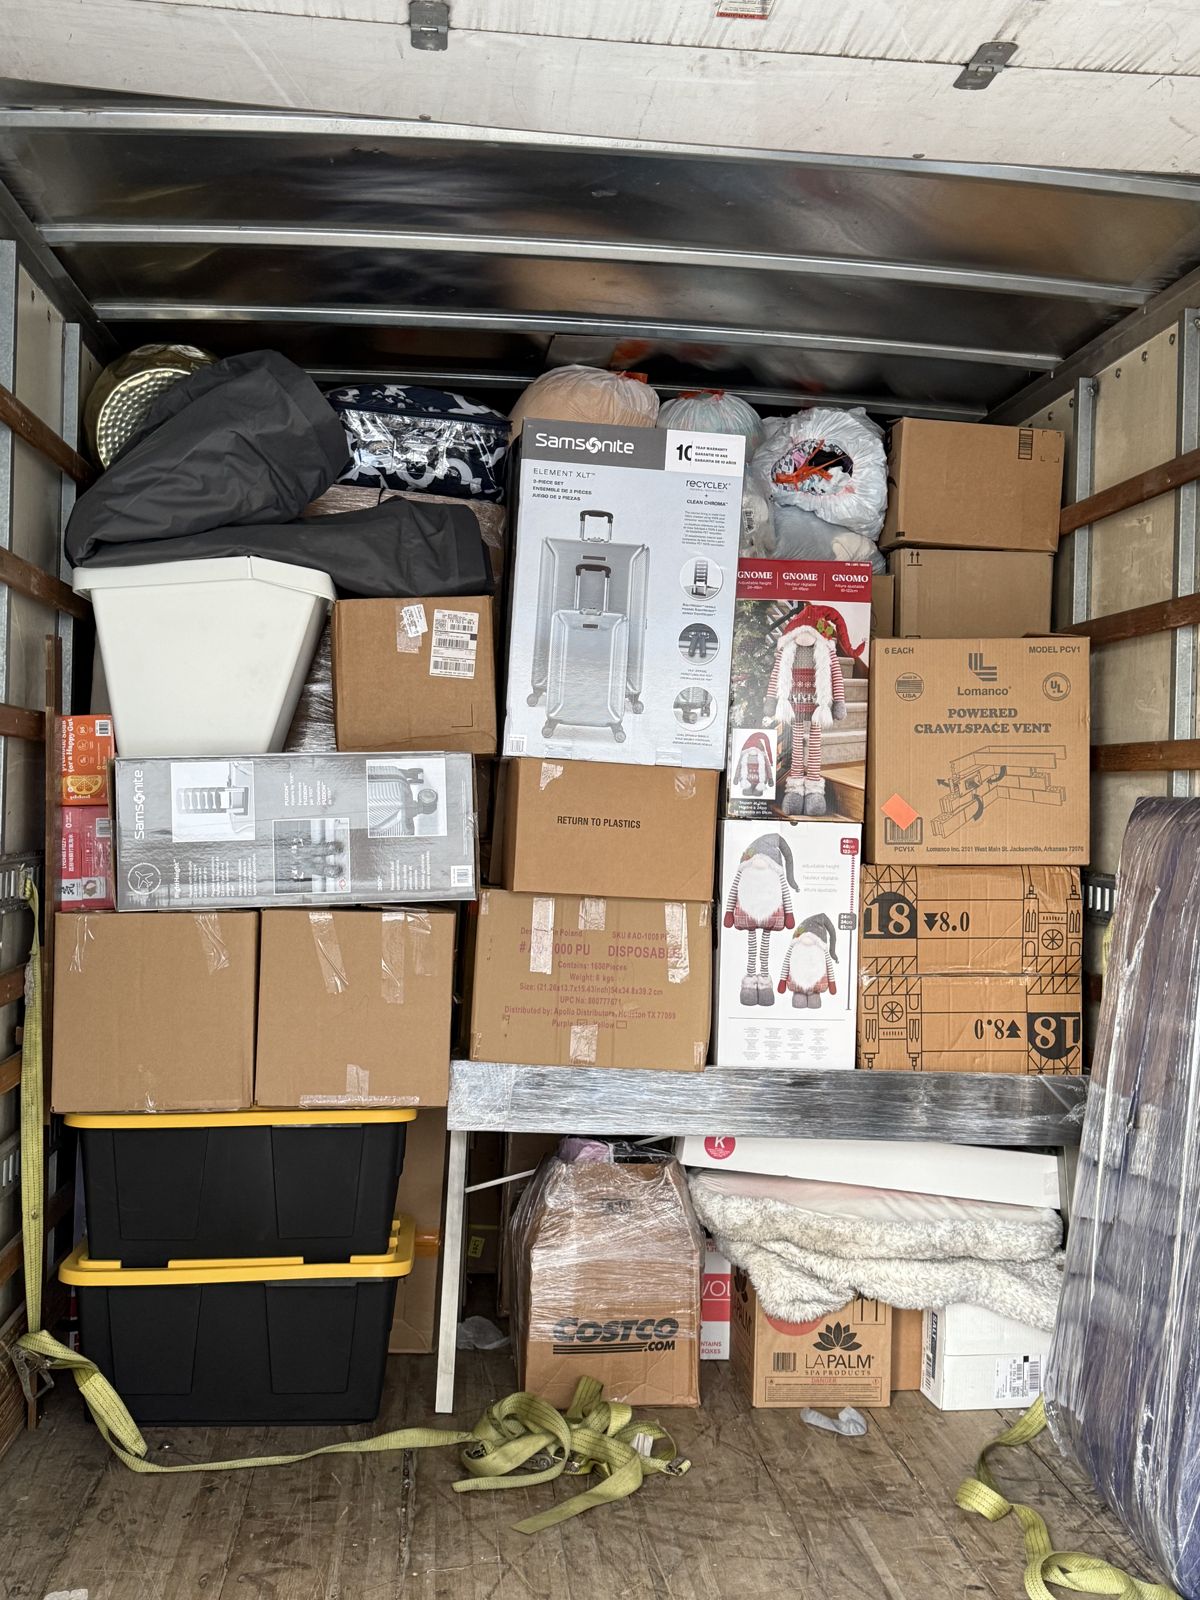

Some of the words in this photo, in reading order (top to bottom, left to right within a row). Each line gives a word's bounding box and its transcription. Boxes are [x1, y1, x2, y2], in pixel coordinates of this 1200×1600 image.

[535, 432, 635, 454] Samsonite
[533, 467, 573, 478] ELEMENT
[737, 571, 773, 580] GNOME
[782, 572, 818, 581] GNOME
[832, 574, 869, 583] GNOMO
[891, 647, 914, 655] EACH
[1028, 646, 1058, 654] MODEL
[1060, 646, 1080, 654] PCV1
[957, 687, 1009, 696] Lomanco
[948, 708, 1018, 718] POWERED
[914, 723, 1010, 734] CRAWLSPACE
[1012, 723, 1051, 733] VENT
[67, 733, 75, 755] Happy
[133, 769, 145, 839] Samsonite
[557, 816, 589, 826] RETURN
[591, 818, 601, 826] TO
[603, 818, 641, 829] PLASTICS
[864, 903, 912, 935] 18
[940, 912, 970, 932] 8.0
[560, 929, 583, 937] Poland
[612, 931, 626, 939] SKU
[575, 944, 590, 956] PU
[558, 961, 590, 970] Contains:
[570, 973, 594, 982] Weight:
[520, 983, 536, 991] Size:
[560, 996, 574, 1004] UPC
[505, 1006, 541, 1014] Distributed
[542, 1007, 553, 1016] by:
[554, 1008, 575, 1016] Apollo
[576, 1008, 617, 1018] Distributors,
[552, 1019, 573, 1028] Purple
[974, 1019, 1005, 1040] 8.0
[1034, 1016, 1080, 1049] 18
[552, 1317, 679, 1342] COSTCO
